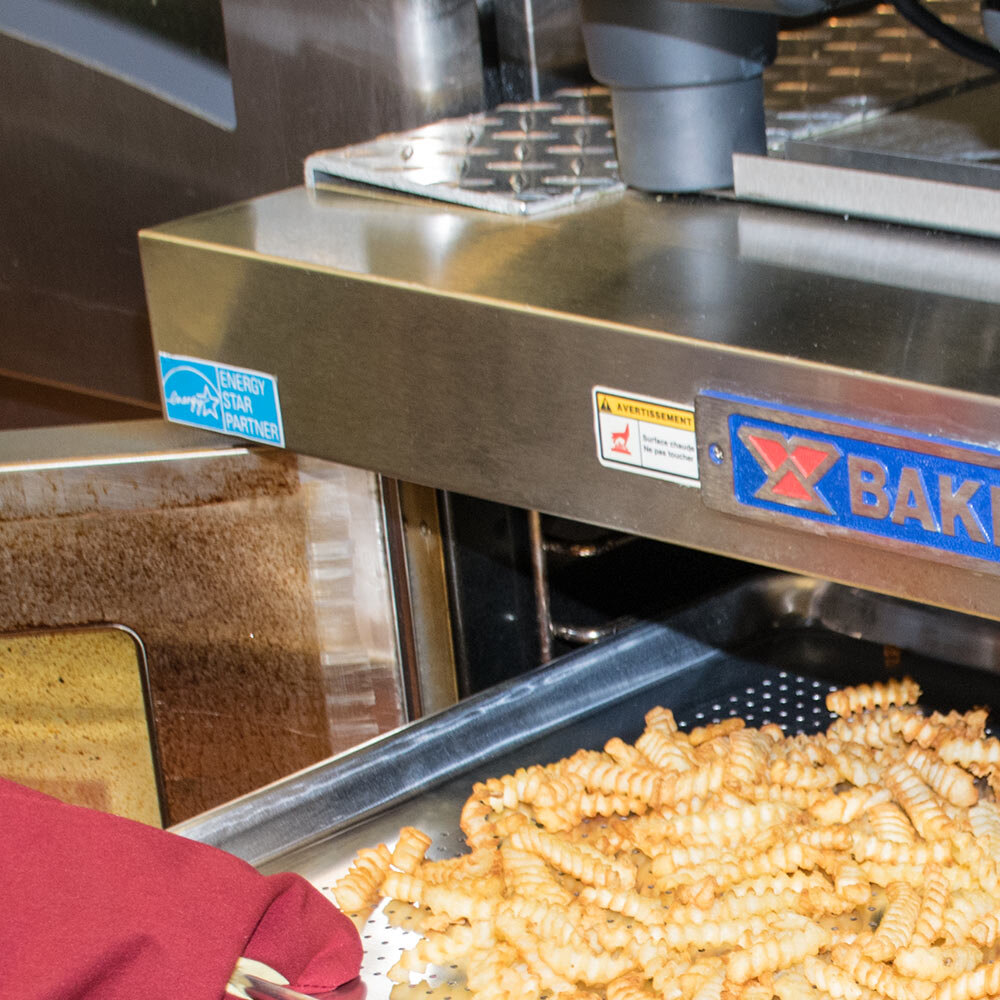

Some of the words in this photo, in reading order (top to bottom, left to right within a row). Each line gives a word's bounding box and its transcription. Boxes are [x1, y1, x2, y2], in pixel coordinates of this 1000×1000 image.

[220, 371, 265, 397] ENERGY
[222, 391, 253, 414] STAR
[225, 412, 280, 441] PARTNER
[616, 403, 692, 427] AVERTISSEMENT
[642, 434, 668, 447] Surface
[643, 445, 653, 454] Ne
